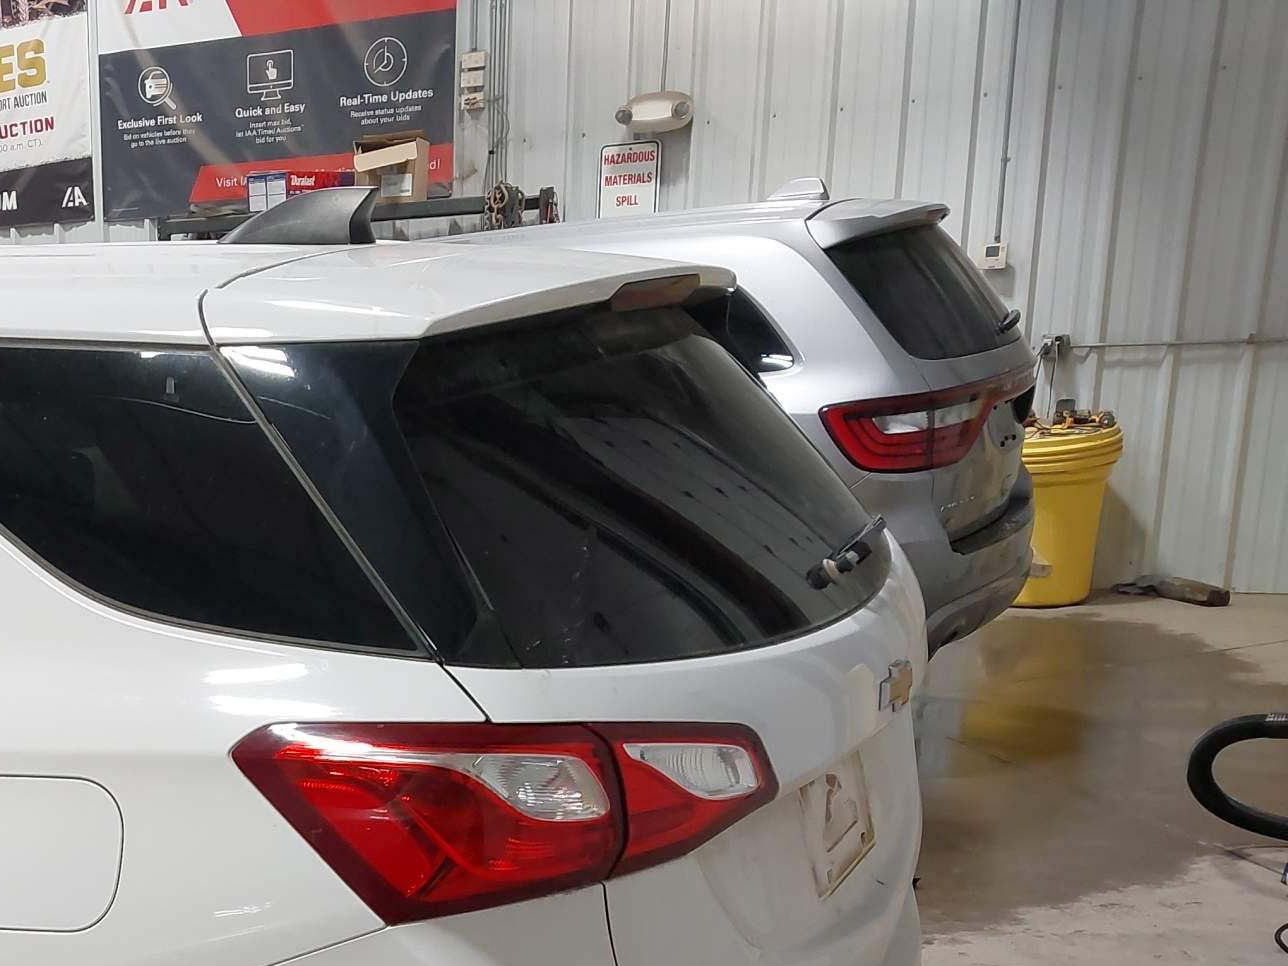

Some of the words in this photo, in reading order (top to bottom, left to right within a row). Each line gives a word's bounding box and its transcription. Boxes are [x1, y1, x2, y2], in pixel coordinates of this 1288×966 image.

[13, 90, 48, 107] AUCTION
[339, 93, 388, 107] Real-Time
[391, 89, 434, 103] Updates
[235, 106, 263, 118] Quick
[264, 104, 282, 115] and
[284, 102, 306, 113] Easy
[117, 117, 156, 130] Exclusive
[157, 115, 177, 125] First
[180, 112, 203, 123] Look
[604, 150, 655, 165] HAZARDOUS
[215, 177, 238, 187] Visit
[604, 171, 653, 187] MATERIALS
[616, 194, 639, 207] SPILL
